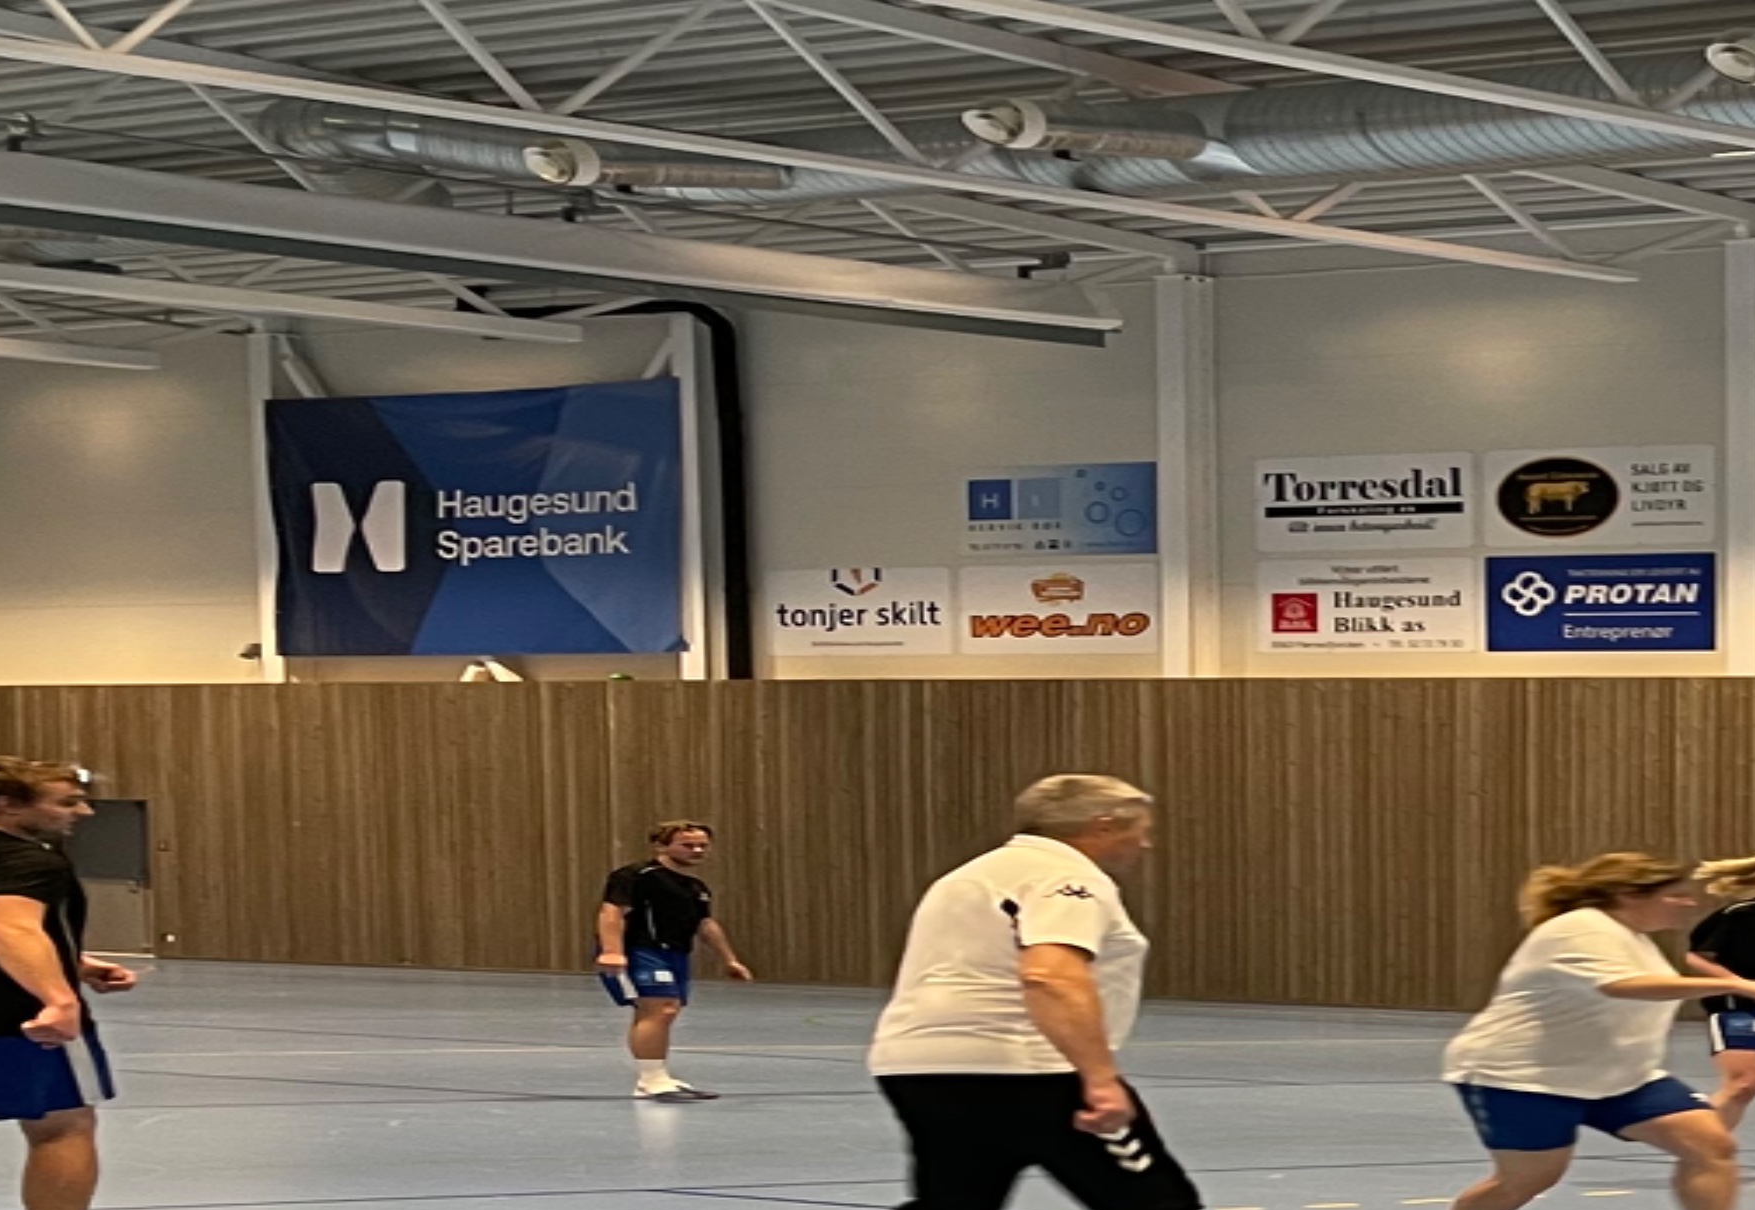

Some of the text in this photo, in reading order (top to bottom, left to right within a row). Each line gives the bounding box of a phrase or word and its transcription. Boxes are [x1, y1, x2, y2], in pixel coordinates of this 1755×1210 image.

[1262, 466, 1464, 503] Torresdal
[436, 482, 638, 525] Haugesund
[436, 525, 631, 567] Sparebank
[1333, 590, 1462, 612] Haugesund
[1563, 583, 1700, 604] PROTAN
[775, 601, 942, 631] tonjer skilt
[1333, 616, 1426, 633] Blikk as
[1562, 623, 1674, 642] Entreprenør
